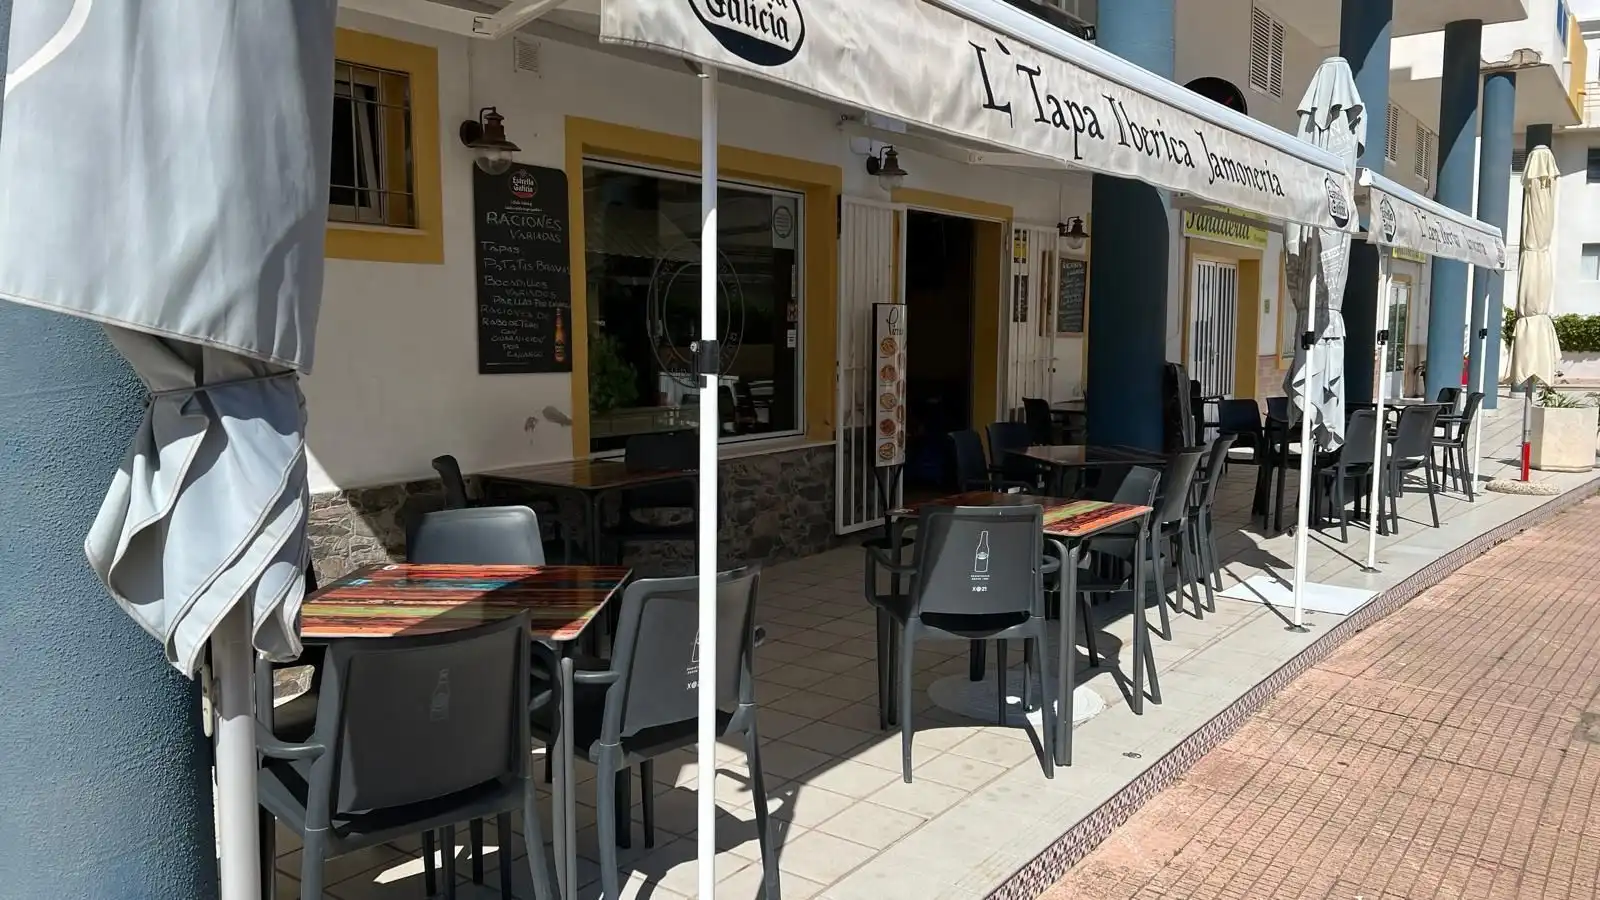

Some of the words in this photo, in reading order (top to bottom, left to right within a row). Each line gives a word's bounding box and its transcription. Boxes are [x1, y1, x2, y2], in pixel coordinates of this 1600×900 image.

[1016, 63, 1104, 159] Tapa
[1102, 93, 1195, 168] Iberica
[1195, 129, 1285, 198] Jamoneria
[486, 211, 562, 231] RACIONES
